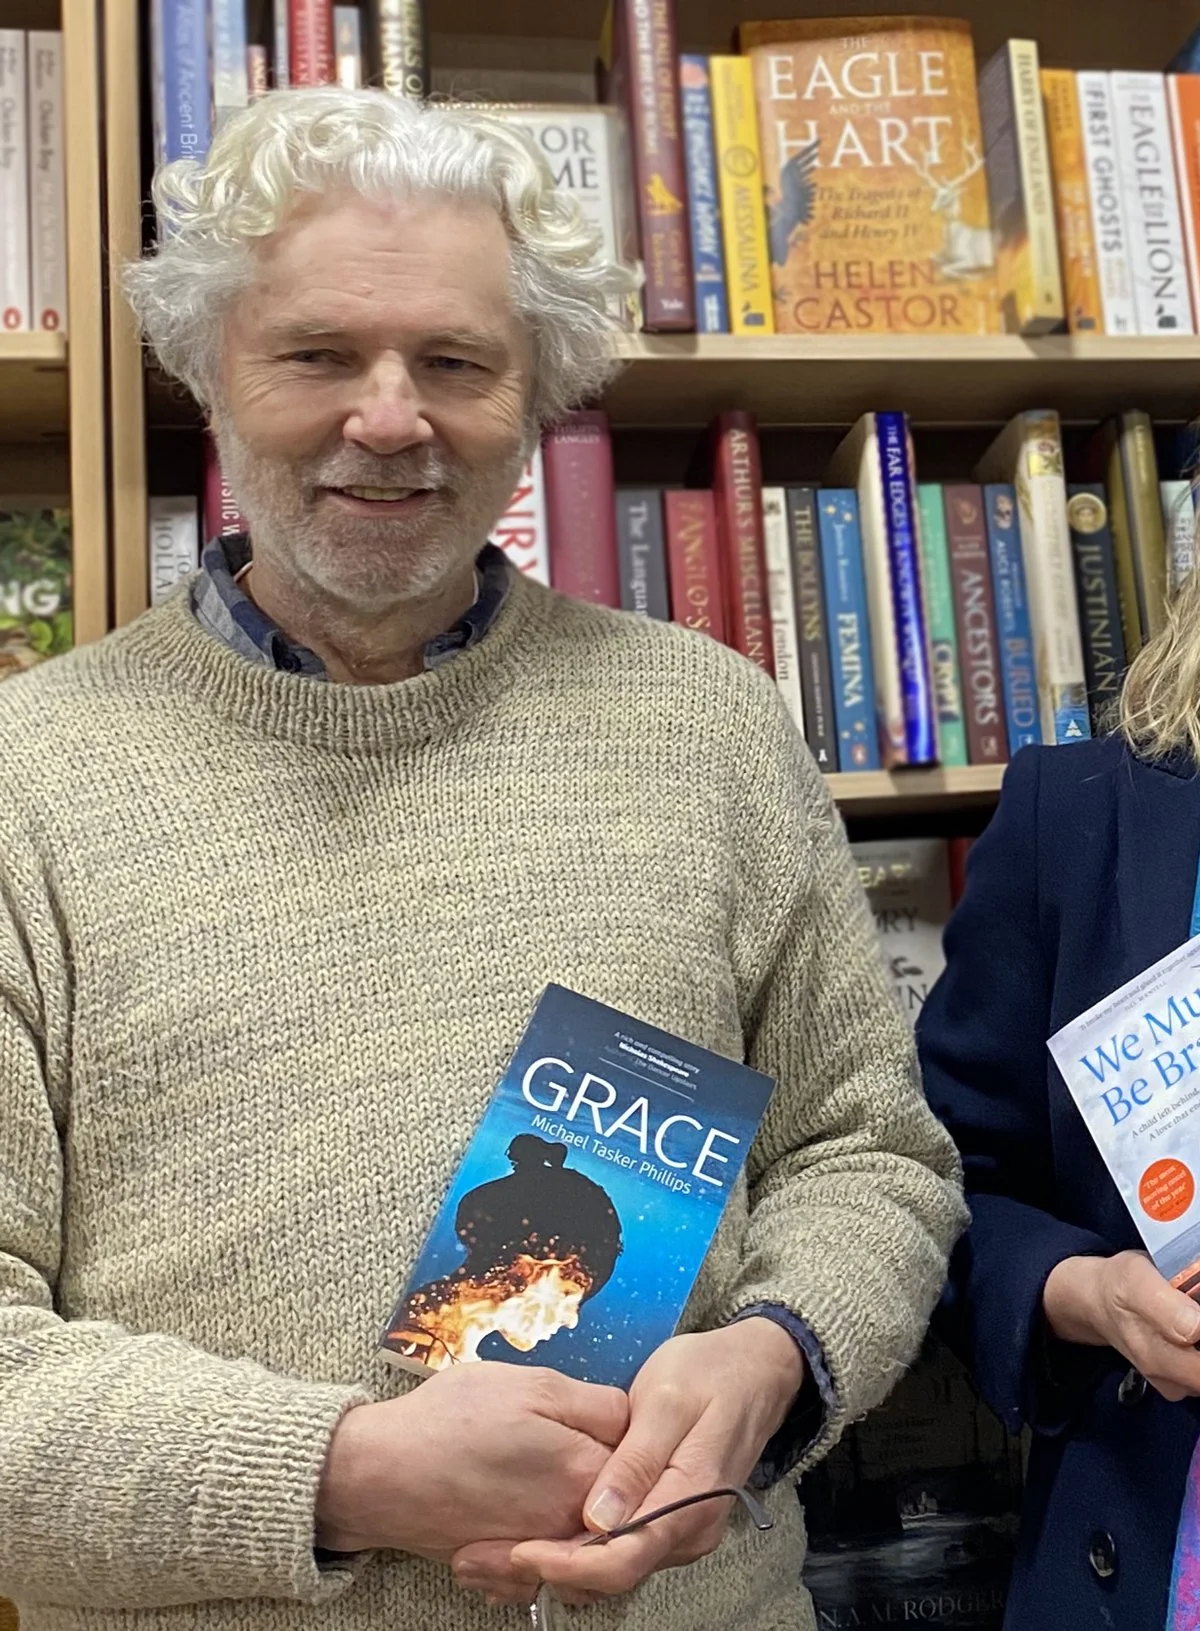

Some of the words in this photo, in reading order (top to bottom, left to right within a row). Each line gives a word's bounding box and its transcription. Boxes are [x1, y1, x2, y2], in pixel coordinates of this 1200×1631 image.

[843, 38, 868, 48] THE
[176, 69, 195, 129] Ancient
[768, 52, 949, 100] EAGLE
[1015, 52, 1037, 106] HARRY
[178, 132, 204, 161] Brit
[776, 116, 952, 169] HART
[1085, 90, 1111, 150] FIRST
[1126, 102, 1168, 202] EAGLE
[1092, 155, 1123, 253] GHOSTS
[731, 182, 762, 293] MESSALINA
[1142, 219, 1179, 302] LION
[813, 262, 935, 289] HELEN
[793, 298, 963, 329] CASTOR
[886, 447, 900, 476] FAR
[627, 501, 649, 538] The
[793, 506, 814, 549] THE
[889, 481, 904, 527] EDGES
[155, 516, 174, 603] HOLLA
[995, 539, 1009, 574] ALICE
[796, 550, 823, 641] BOLEYNS
[1077, 543, 1118, 692] JUSTINIAN
[773, 618, 792, 681] London
[835, 611, 865, 707] FEMINA
[958, 567, 997, 726] ANCESTORS
[1004, 636, 1036, 728] BURIED
[1079, 1029, 1142, 1083] We
[521, 1057, 740, 1188] GRACE
[1100, 1077, 1155, 1127] Be
[1130, 1129, 1139, 1139] A
[1135, 1115, 1159, 1133] child
[1156, 1105, 1172, 1120] left
[1147, 1131, 1156, 1141] A
[1154, 1119, 1174, 1136] love
[1171, 1109, 1190, 1125] that
[531, 1114, 590, 1150] Michael
[591, 1138, 638, 1170] Tasker
[639, 1161, 692, 1196] Phillips
